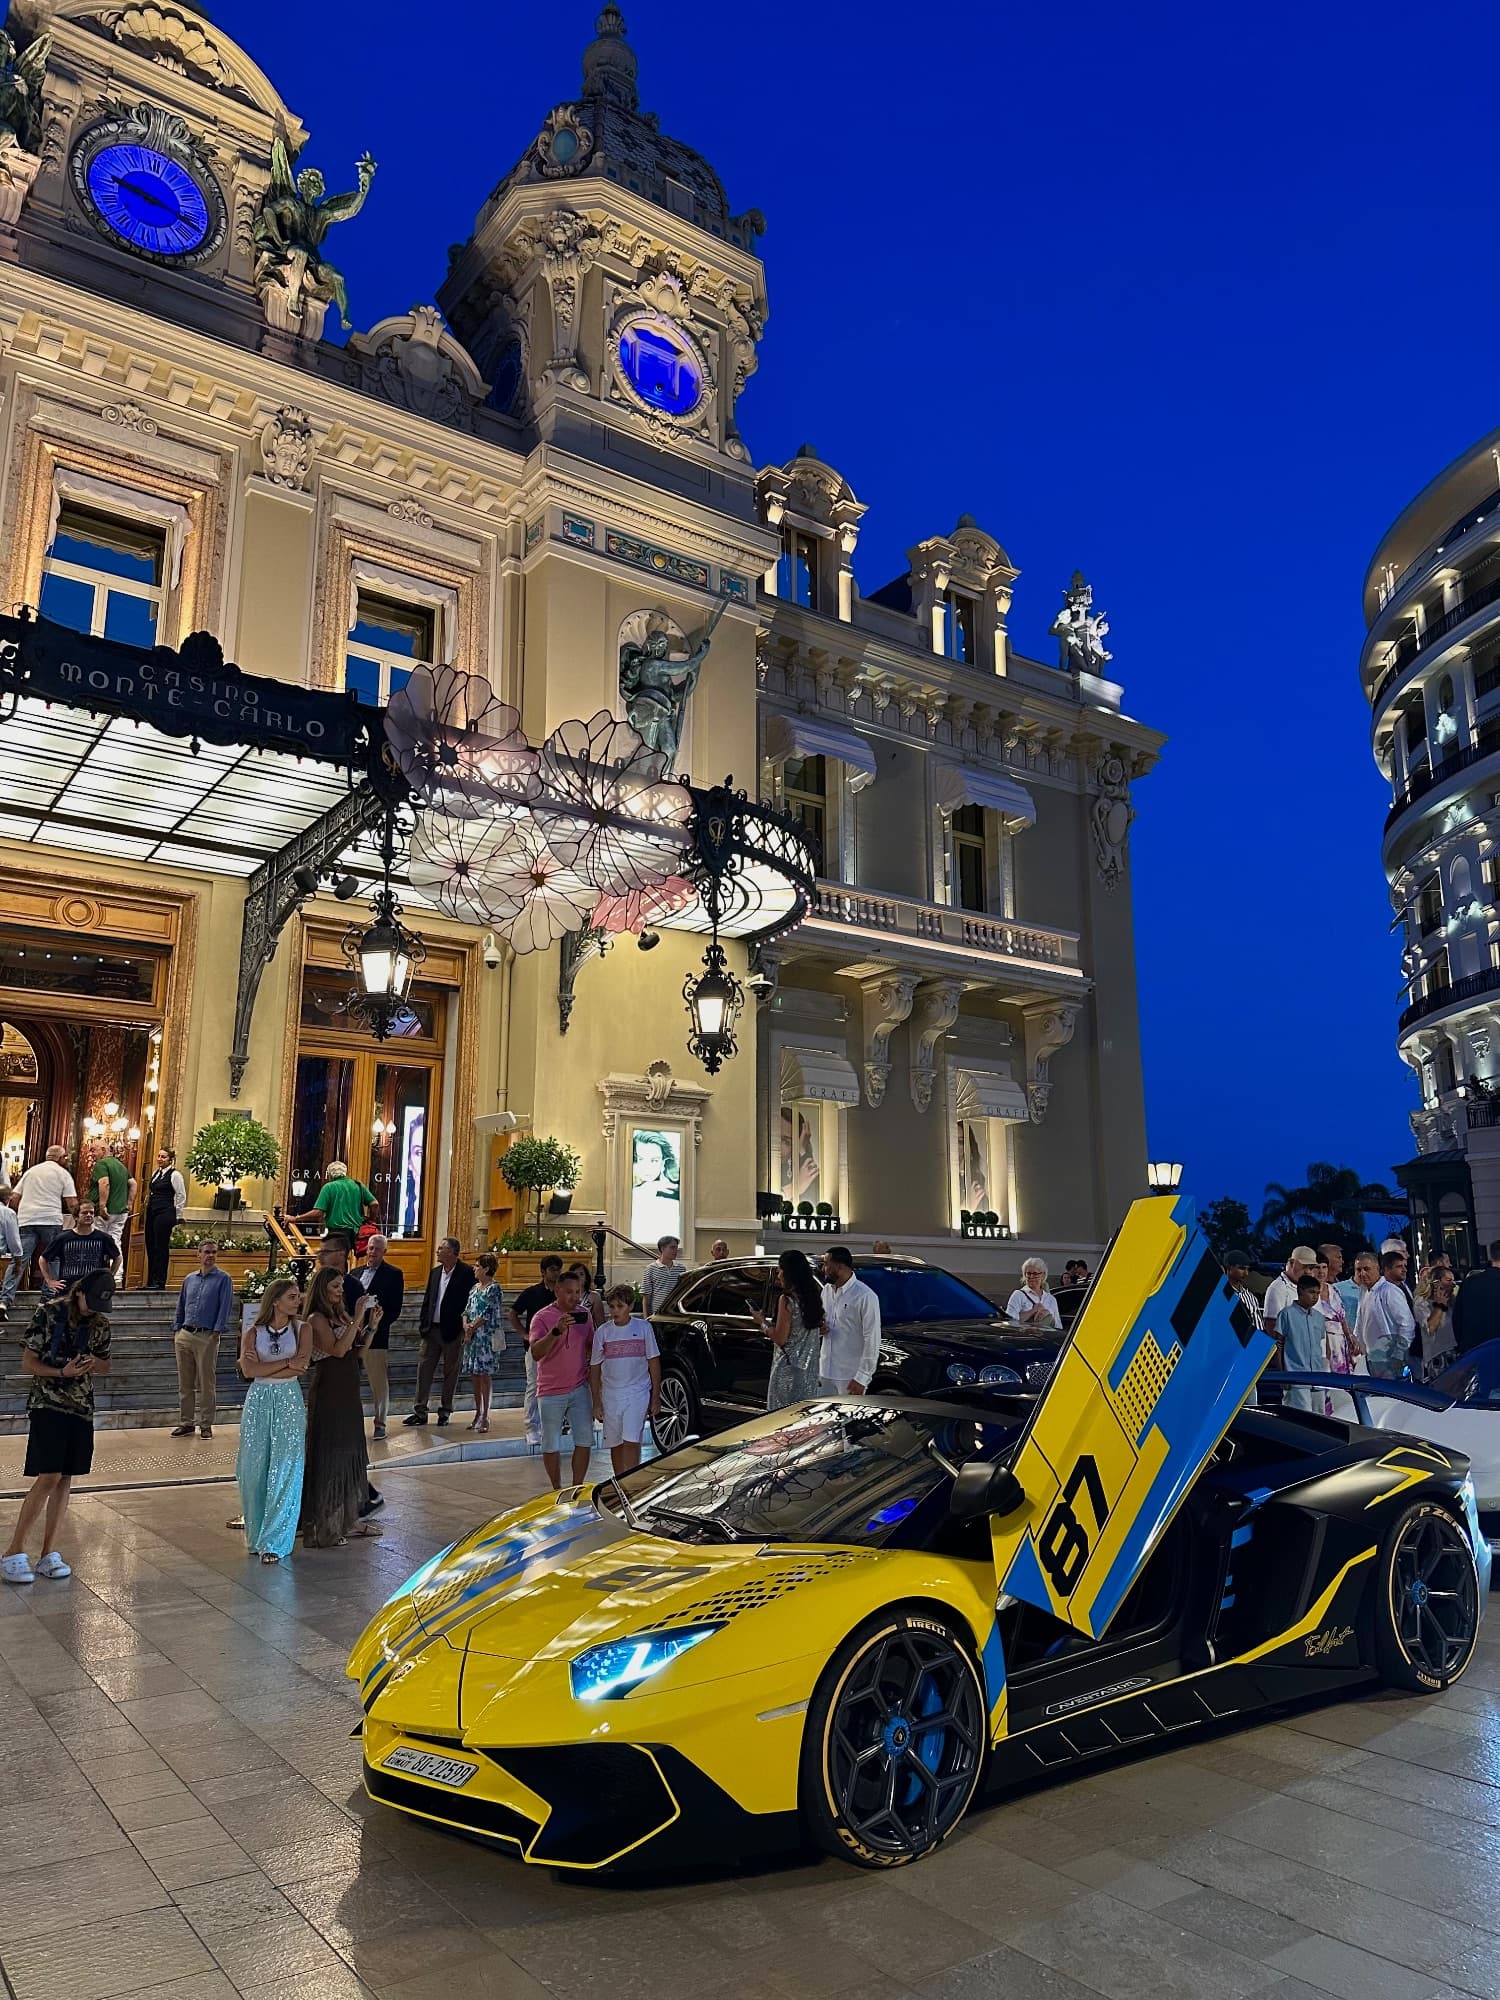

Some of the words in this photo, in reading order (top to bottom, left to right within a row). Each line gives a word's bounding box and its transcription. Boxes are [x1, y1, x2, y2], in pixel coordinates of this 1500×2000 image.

[138, 664, 259, 705] CASINO
[58, 662, 326, 737] MONTE-CARLO
[788, 1217, 838, 1232] GRAFF
[967, 1226, 1009, 1238] GRAFF
[1038, 1454, 1110, 1597] 87
[583, 1565, 711, 1593] 87
[906, 1617, 946, 1637] PIRELLI
[1058, 1680, 1137, 1710] AVENTADOR
[411, 1754, 472, 1783] 80-22599
[836, 1828, 914, 1866] ZERO
